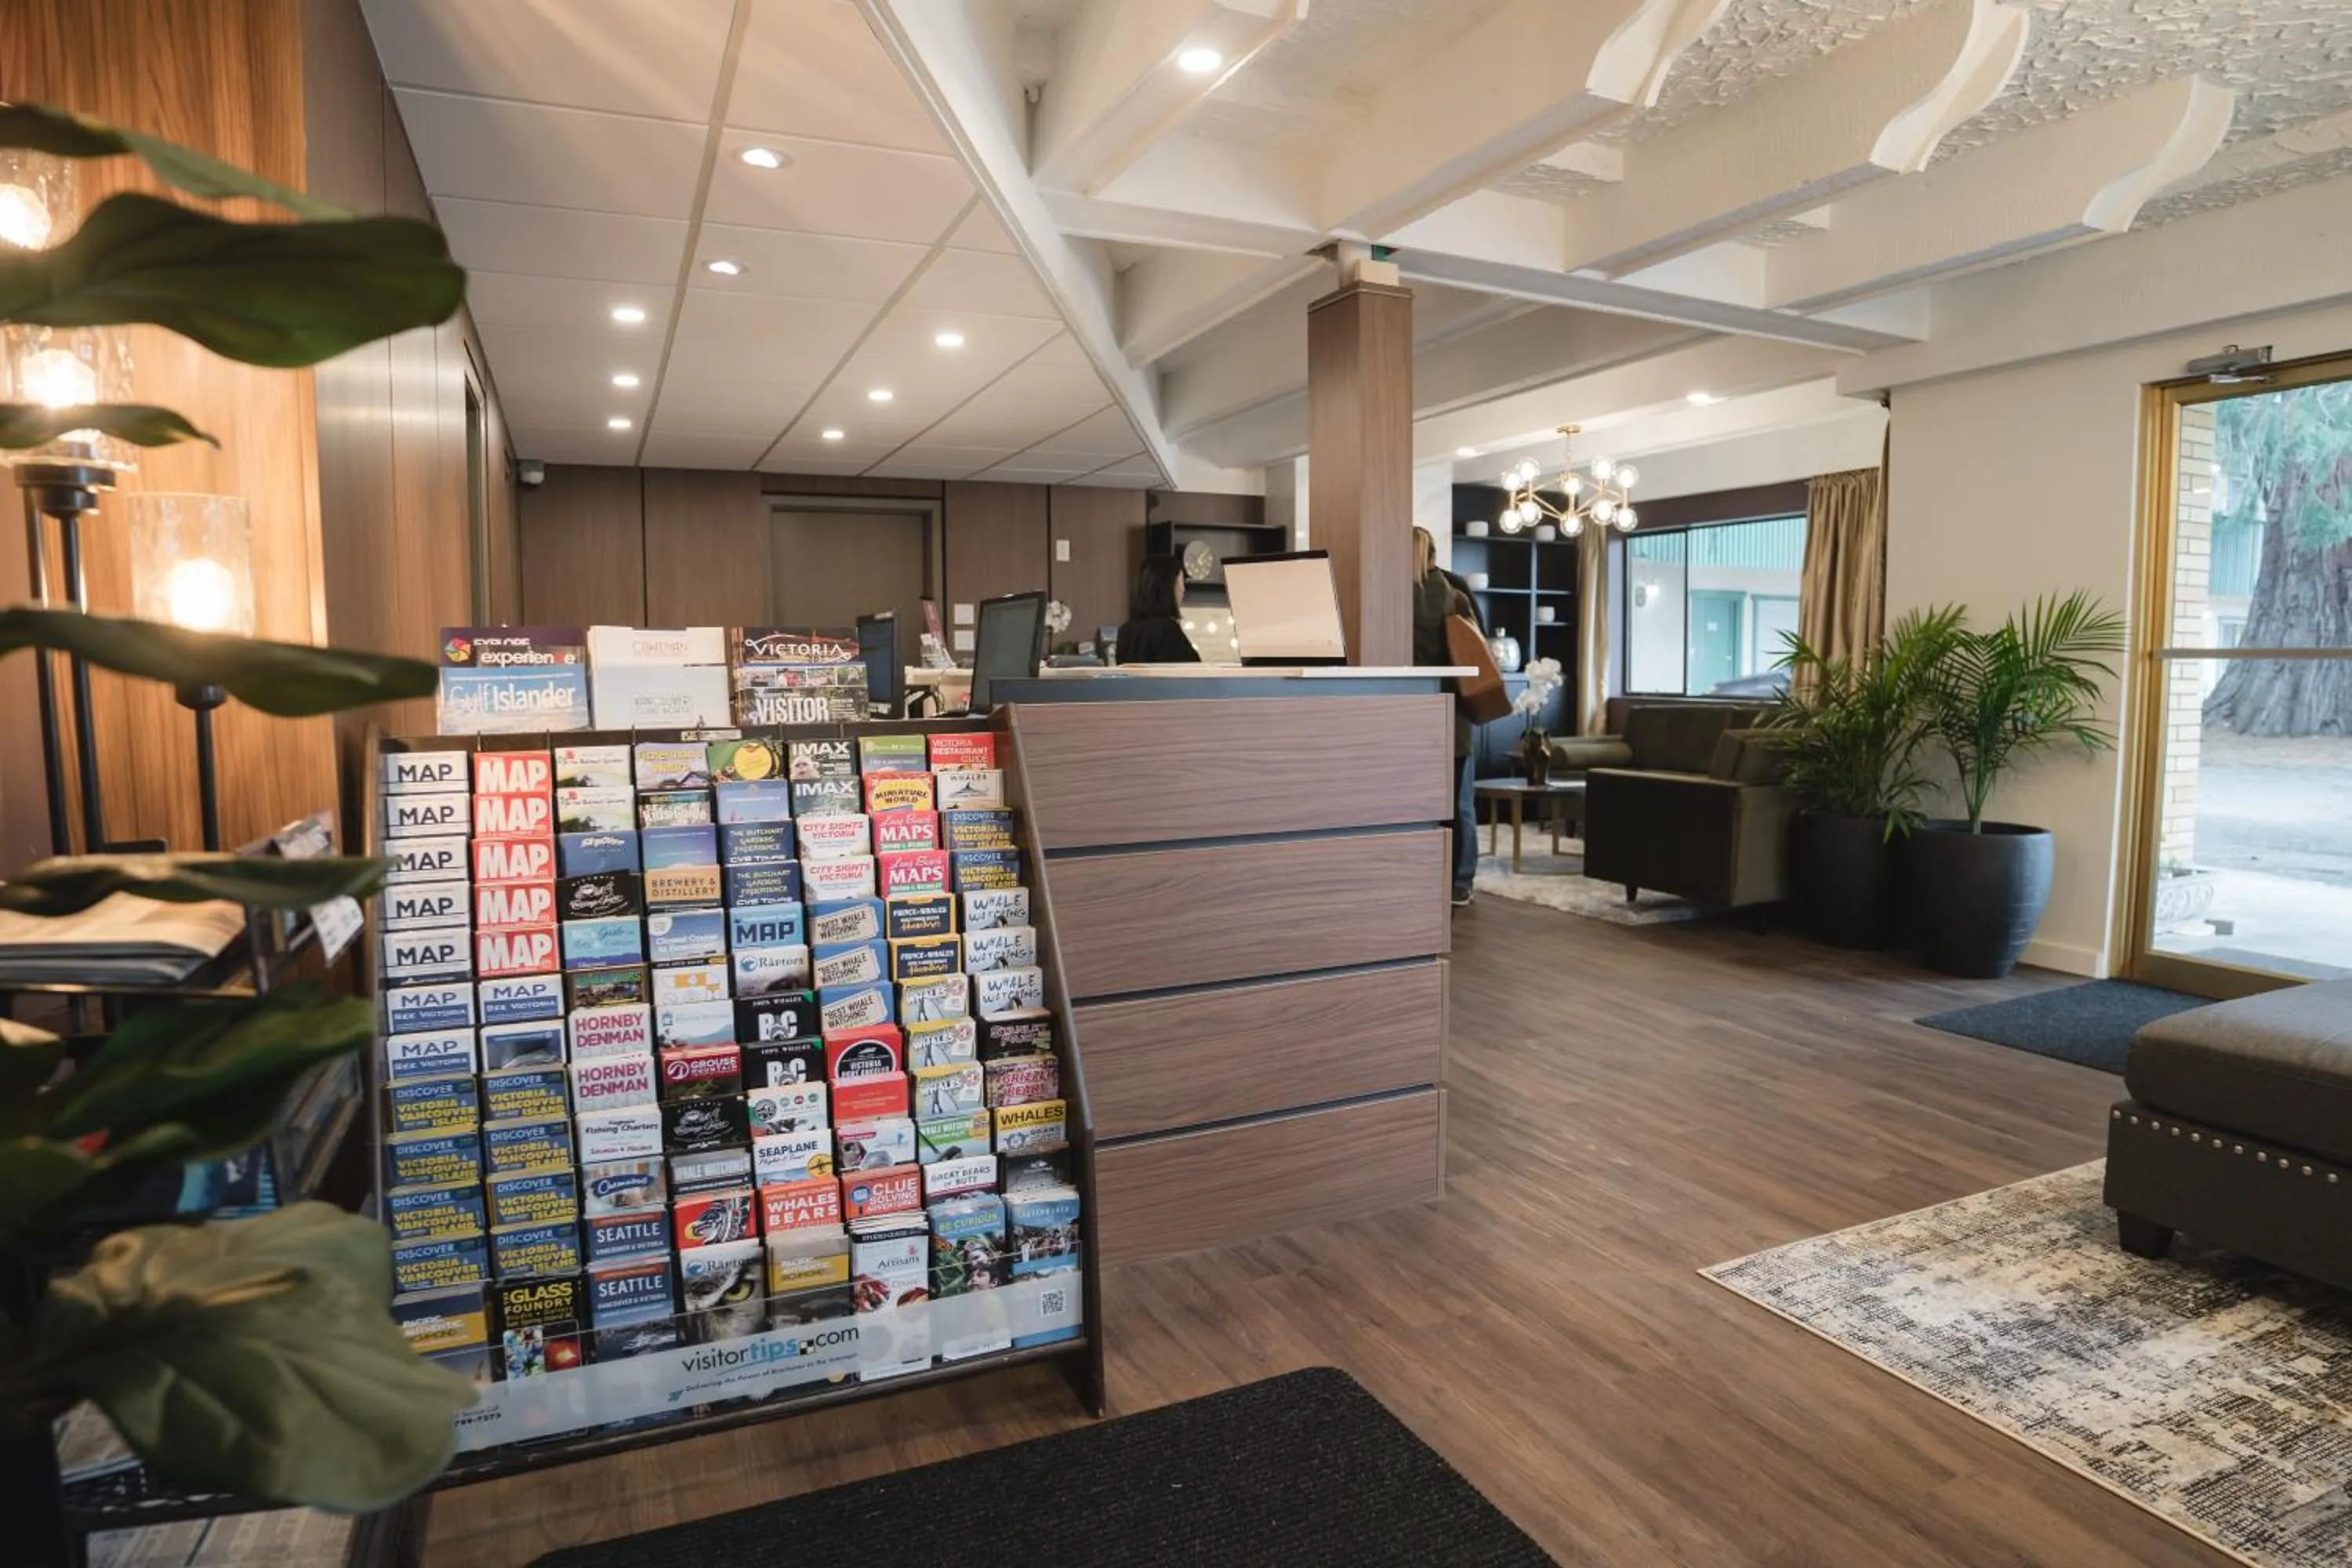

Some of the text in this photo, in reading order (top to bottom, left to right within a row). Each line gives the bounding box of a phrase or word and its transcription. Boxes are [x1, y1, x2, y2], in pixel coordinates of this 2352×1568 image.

[493, 681, 575, 712] Islander
[753, 697, 829, 724] VISITOR
[793, 742, 850, 755] IMAX
[398, 764, 452, 782] MAP
[479, 757, 548, 793] MAP
[796, 781, 854, 797] IMAX
[875, 789, 929, 800] MINIATURE
[884, 795, 919, 804] WORLD
[399, 806, 454, 826] MAP
[478, 797, 548, 832] MAP
[953, 811, 994, 822] DISCOVER
[828, 821, 864, 829] SIGHTS
[812, 830, 855, 839] VICTORIA
[879, 824, 935, 843] MAPS
[397, 851, 452, 871] MAP
[478, 843, 550, 879] MAP
[960, 852, 1001, 862] DISCOVER
[834, 862, 871, 872] SIGHTS
[960, 866, 1004, 874] VICTORIA
[652, 877, 704, 887] BREWERY
[818, 872, 862, 880] VICTORIA
[889, 866, 944, 885] MAPS
[960, 873, 1017, 882] VANCOUVER
[652, 887, 717, 898] DISTILLERY
[396, 898, 453, 918] MAP
[479, 887, 551, 924] MAP
[974, 894, 1022, 909] WHALE
[840, 909, 866, 924] WHALE
[968, 909, 1026, 923] WATCHING
[736, 920, 795, 943] MAP
[974, 935, 1022, 951] WHALE
[397, 945, 454, 966] MAP
[480, 933, 553, 971] MAP
[969, 949, 1029, 965] WATCHING
[842, 953, 867, 968] WHALE
[988, 975, 1035, 991] WHALE
[493, 984, 547, 999] MAP
[982, 989, 1040, 1004] WATCHING
[401, 992, 457, 1007] MAP
[510, 1000, 556, 1009] VICTORIA
[849, 995, 873, 1011] WHALE
[420, 1009, 466, 1018] VICTORIA
[575, 1012, 643, 1032] HORNBY
[576, 1028, 645, 1047] DENMAN
[401, 1040, 458, 1058] MAP
[394, 1058, 467, 1070] SEE VICTORIA
[691, 1057, 737, 1068] GROUSE
[578, 1062, 647, 1082] HORNBY
[488, 1075, 543, 1088] DISCOVER
[579, 1077, 648, 1098] DENMAN
[396, 1084, 453, 1098] DISCOVER
[489, 1088, 546, 1102] VICTORIA
[398, 1098, 458, 1112] VICTORIA
[489, 1096, 564, 1111] VANCOUVER
[522, 1105, 565, 1116] ISLAND
[399, 1106, 477, 1121] VANCOUVER
[433, 1115, 477, 1127] ISLAND
[1001, 1106, 1064, 1125] WHALES
[491, 1127, 545, 1142] DISCOVER
[586, 1123, 619, 1134] Fishing
[622, 1120, 659, 1131] Charters
[395, 1140, 454, 1155] DISCOVER
[491, 1142, 550, 1156] VICTORIA
[759, 1141, 818, 1158] SEAPLANE
[397, 1154, 459, 1169] VICTORIA
[492, 1147, 568, 1164] VANCOUVER
[527, 1156, 569, 1169] ISLAND
[398, 1160, 477, 1177] VANCOUVER
[931, 1166, 991, 1182] GREAT BEARS
[432, 1171, 477, 1183] ISLAND
[955, 1177, 978, 1185] BUTE
[496, 1178, 553, 1192] DISCOVER
[873, 1178, 916, 1194] CLUE
[393, 1192, 451, 1207] DISCOVER
[499, 1192, 557, 1207] VICTORIA
[768, 1192, 836, 1213] WHALES
[869, 1191, 916, 1205] SOLVING
[394, 1206, 456, 1221] VICTORIA
[499, 1198, 575, 1216] VANCOUVER
[532, 1207, 577, 1220] ISLAND
[769, 1204, 838, 1225] BEARS
[394, 1213, 474, 1230] VANCOUVER
[430, 1222, 477, 1235] ISLAND
[497, 1229, 553, 1244] DISCOVER
[597, 1222, 661, 1243] SEATTLE
[395, 1243, 454, 1260] DISCOVER
[499, 1243, 557, 1259] VICTORIA
[397, 1258, 459, 1274] VICTORIA
[500, 1250, 575, 1269] VANCOUVER
[533, 1258, 577, 1271] ISLAND
[398, 1265, 479, 1282] VANCOUVER
[433, 1273, 480, 1286] ISLAND
[510, 1282, 572, 1303] GLASS
[598, 1276, 663, 1297] SEATTLE
[504, 1295, 572, 1315] FOUNDRY
